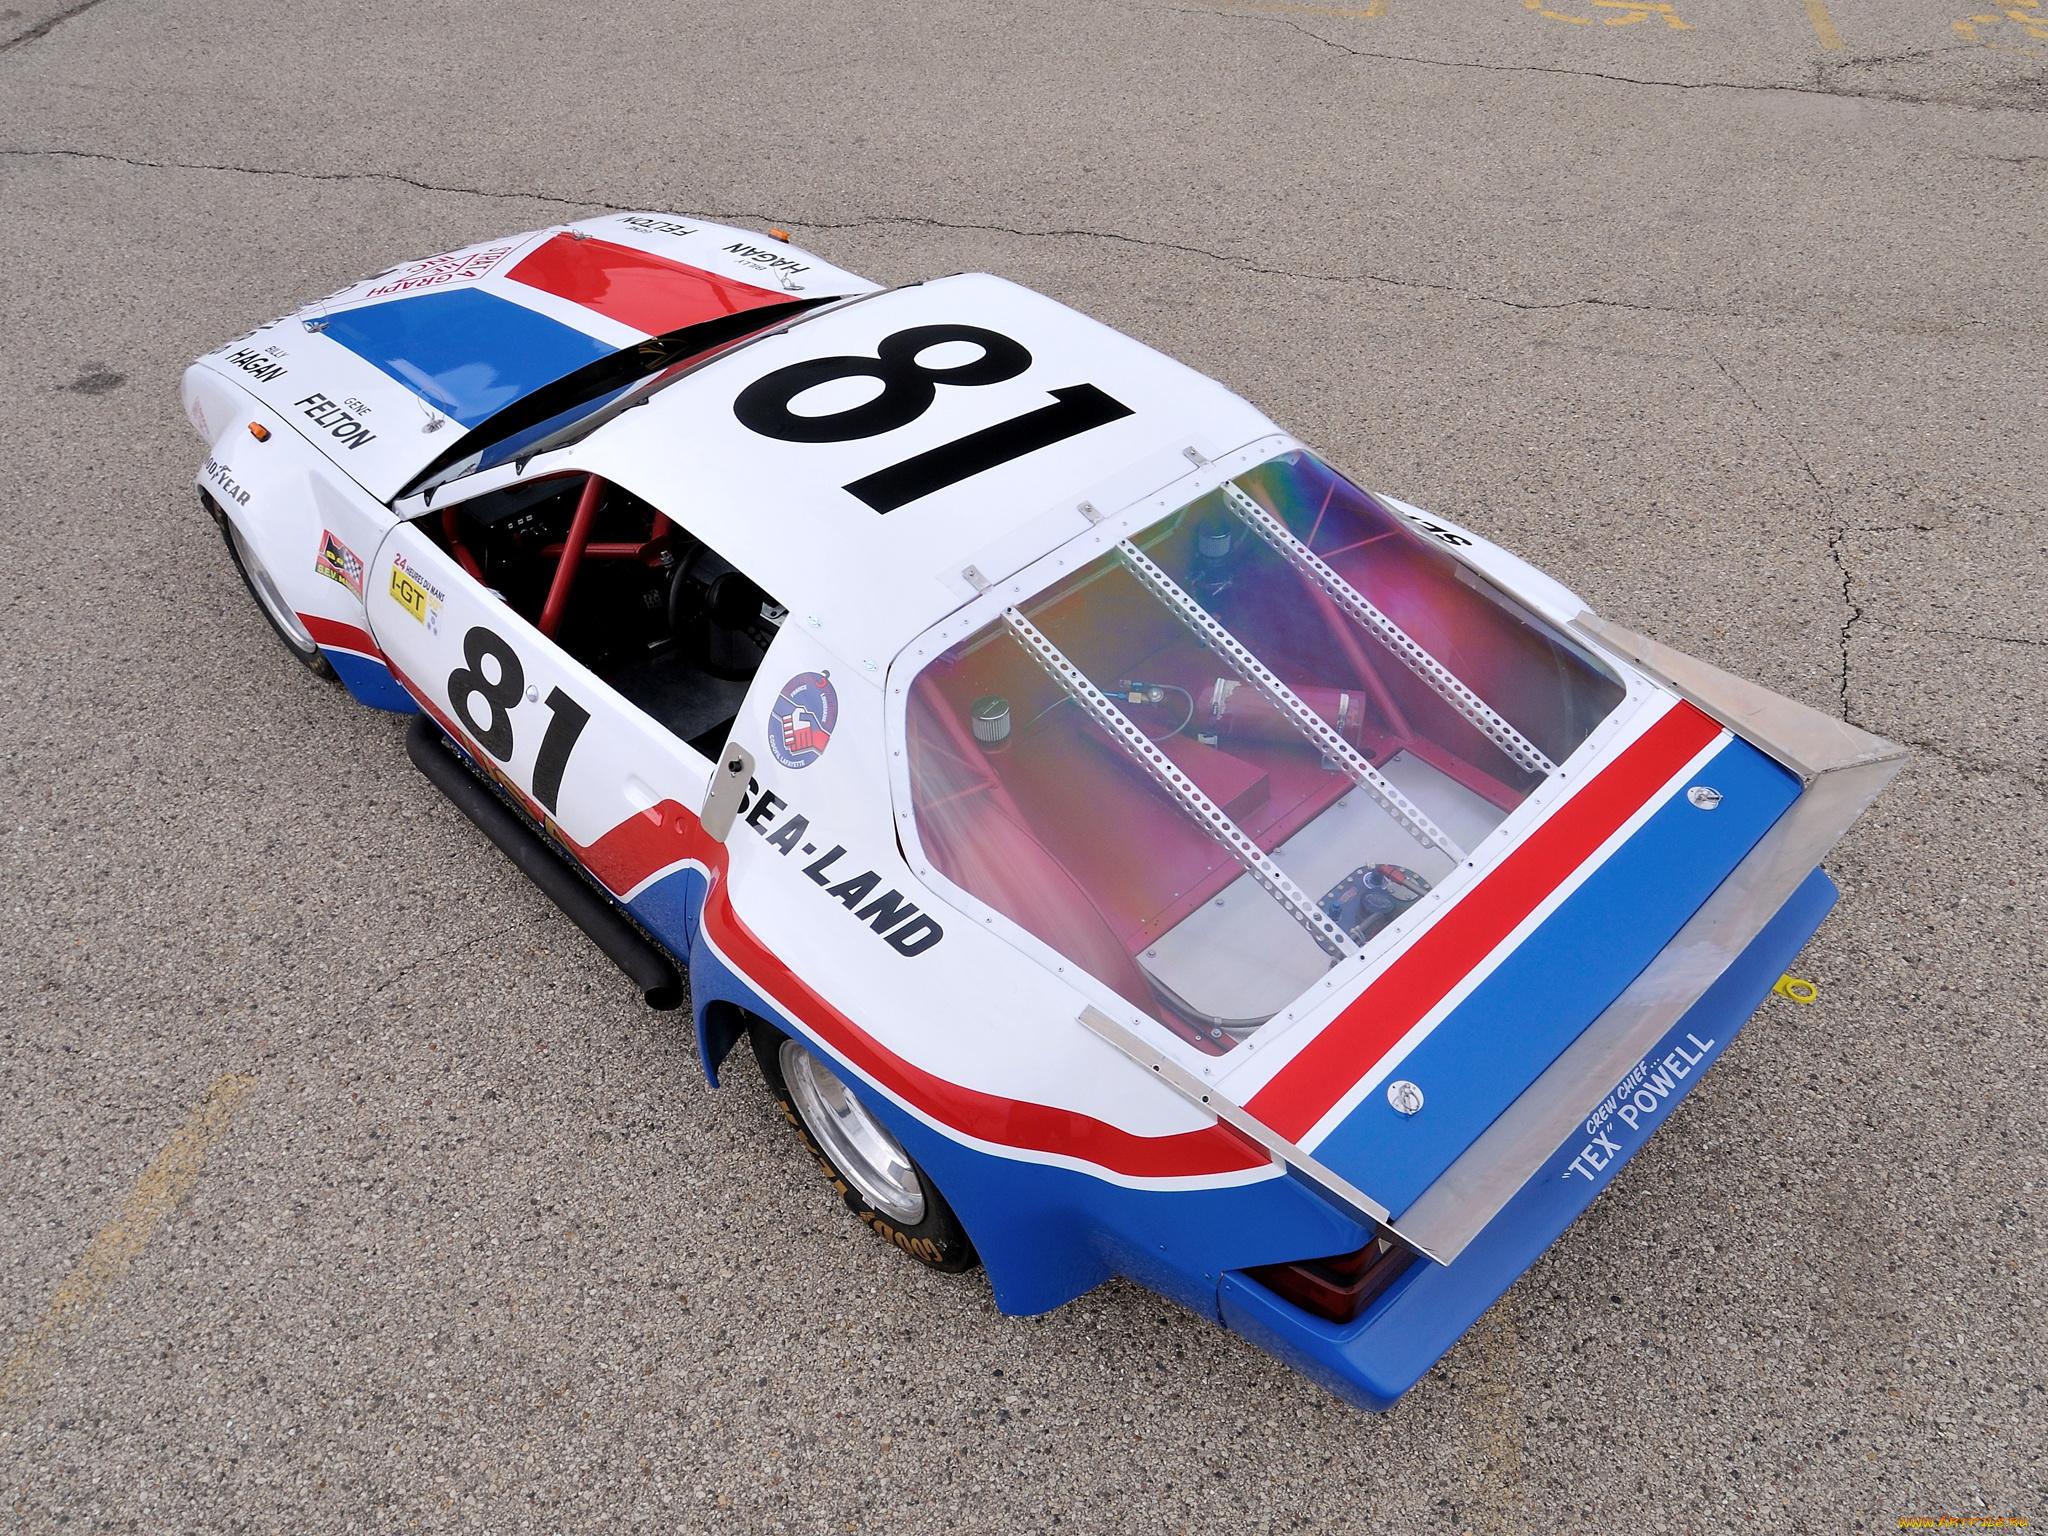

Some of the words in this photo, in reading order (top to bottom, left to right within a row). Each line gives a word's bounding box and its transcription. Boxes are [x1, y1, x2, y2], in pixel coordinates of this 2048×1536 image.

[616, 216, 699, 237] FELTON
[721, 242, 811, 274] HAGAN
[733, 259, 768, 271] BILLY
[225, 347, 288, 383] HAGAN
[265, 345, 290, 359] BILLY
[294, 392, 377, 450] FELTON
[344, 397, 372, 417] GENE
[733, 324, 1137, 515] 81
[392, 570, 425, 611] I-GT
[394, 552, 407, 570] 24
[405, 565, 424, 585] HEURES
[422, 579, 432, 591] DU
[430, 586, 446, 602] MANS
[447, 625, 592, 818] 81
[780, 756, 806, 768] LAFAYETTE
[1617, 1032, 1716, 1132] POWELL
[1586, 1095, 1618, 1136] CREW
